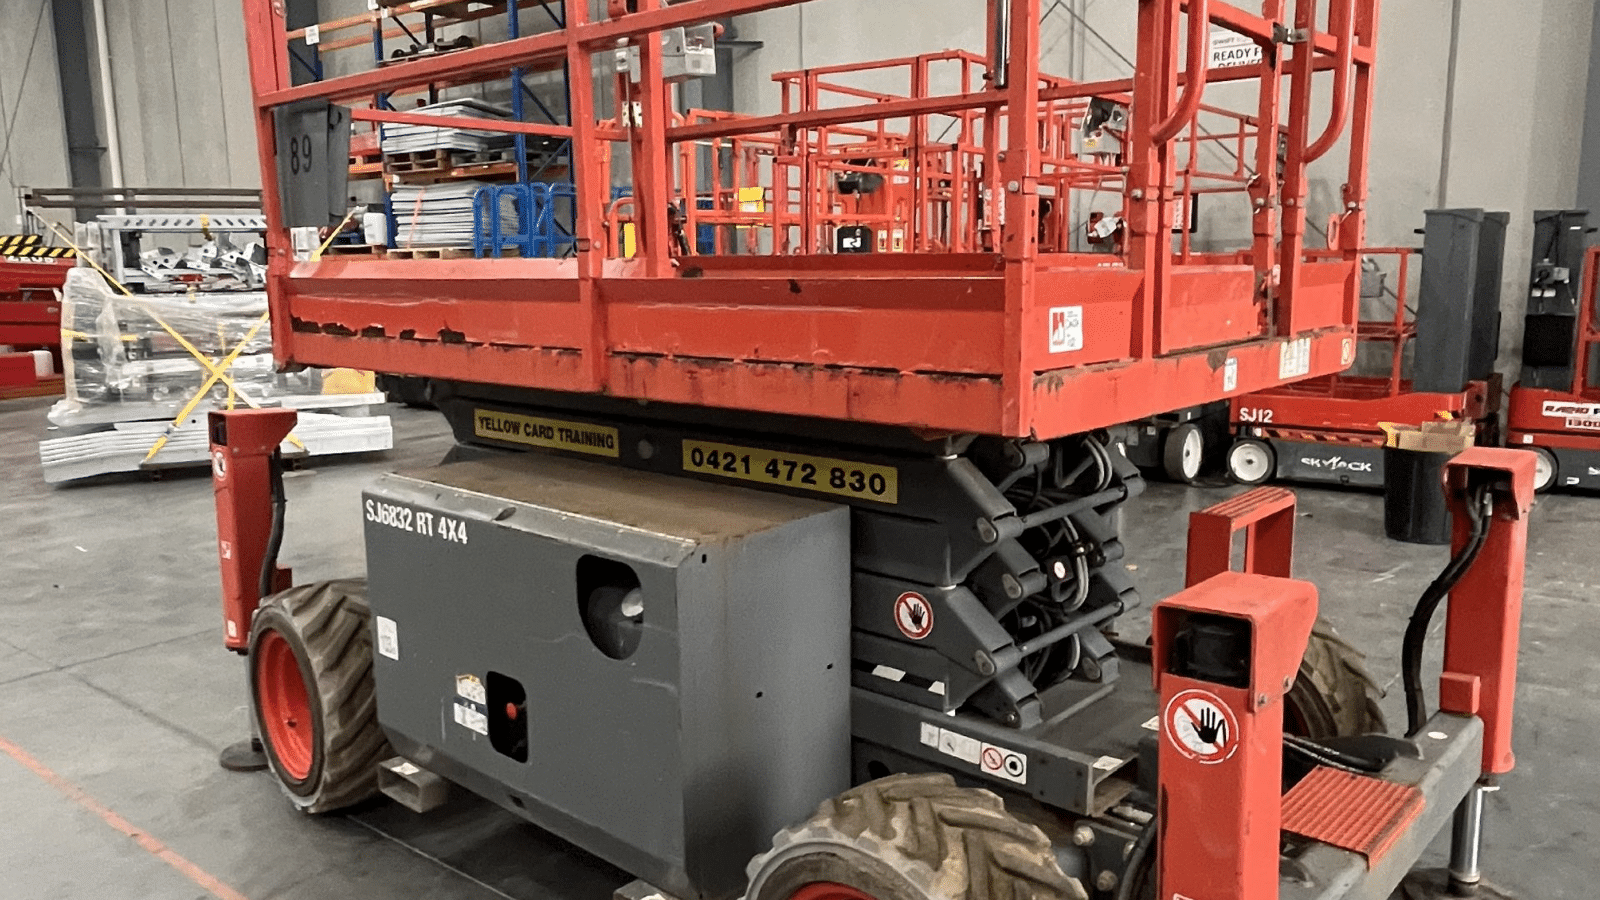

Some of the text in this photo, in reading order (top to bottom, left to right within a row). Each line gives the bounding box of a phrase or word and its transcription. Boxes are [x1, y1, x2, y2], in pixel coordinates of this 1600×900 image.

[1213, 48, 1251, 61] READY
[291, 135, 312, 175] 89
[478, 416, 615, 450] YELLOW CARD TRAINING
[1240, 407, 1273, 423] SJ12
[691, 448, 886, 496] 0421 472 830
[366, 499, 468, 545] SJ6832 RT 4X4
